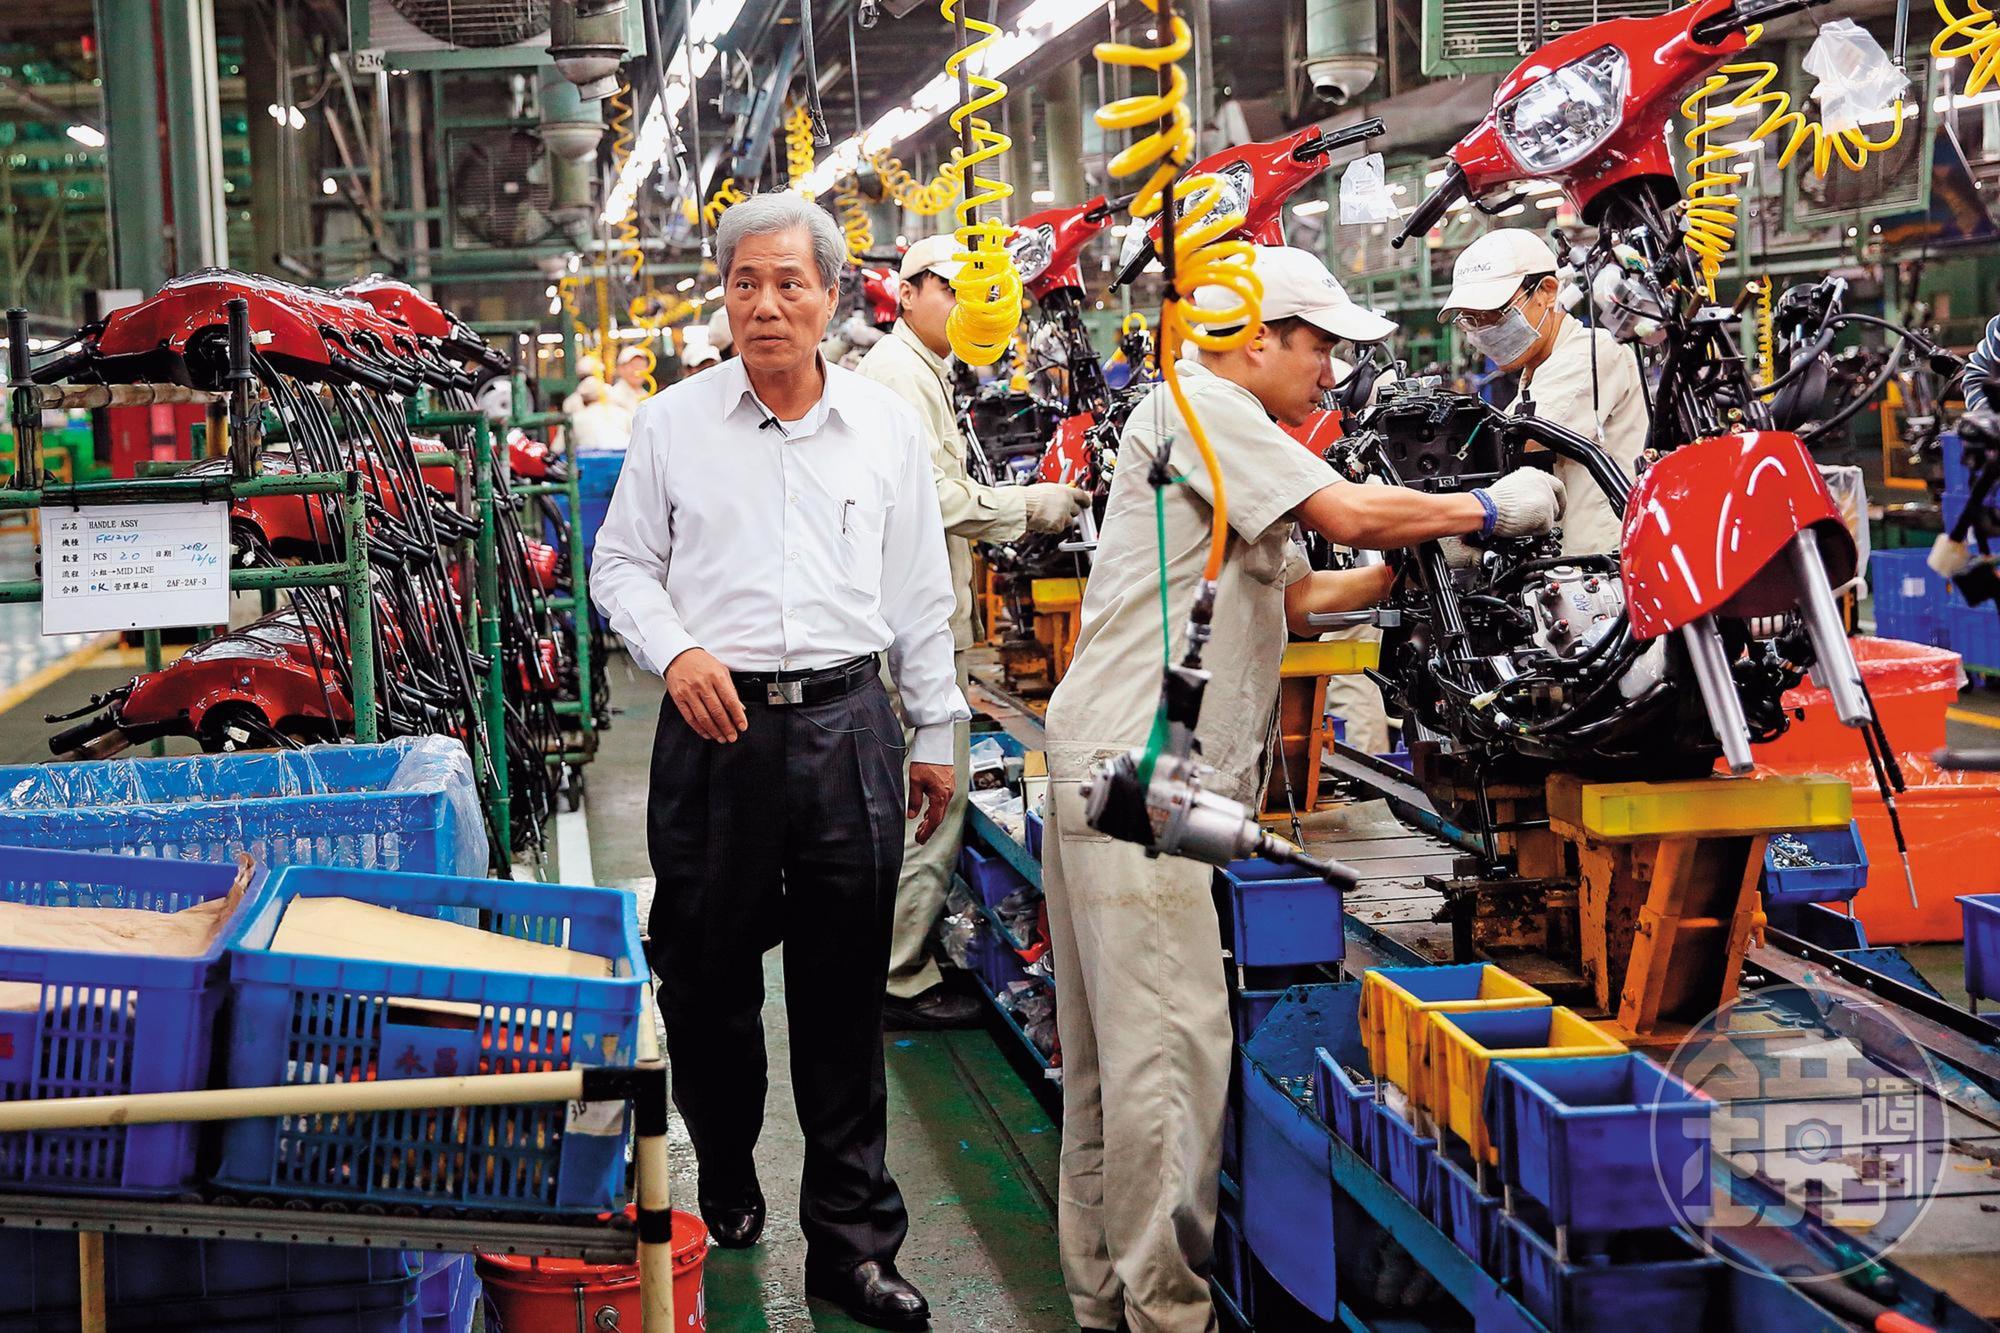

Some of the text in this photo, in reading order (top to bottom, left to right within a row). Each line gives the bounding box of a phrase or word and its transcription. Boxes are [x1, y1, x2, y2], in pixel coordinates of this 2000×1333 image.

[359, 54, 384, 68] 236
[61, 522, 78, 530] 品名
[89, 519, 139, 529] HANDLE ASSY
[62, 538, 79, 547] 機種
[93, 552, 108, 561] PCS
[156, 549, 172, 558] 日期
[135, 566, 155, 574] LINE
[114, 581, 149, 591] 管理單位
[166, 577, 207, 588] 2AF-2AF-3
[62, 585, 79, 594] 合格
